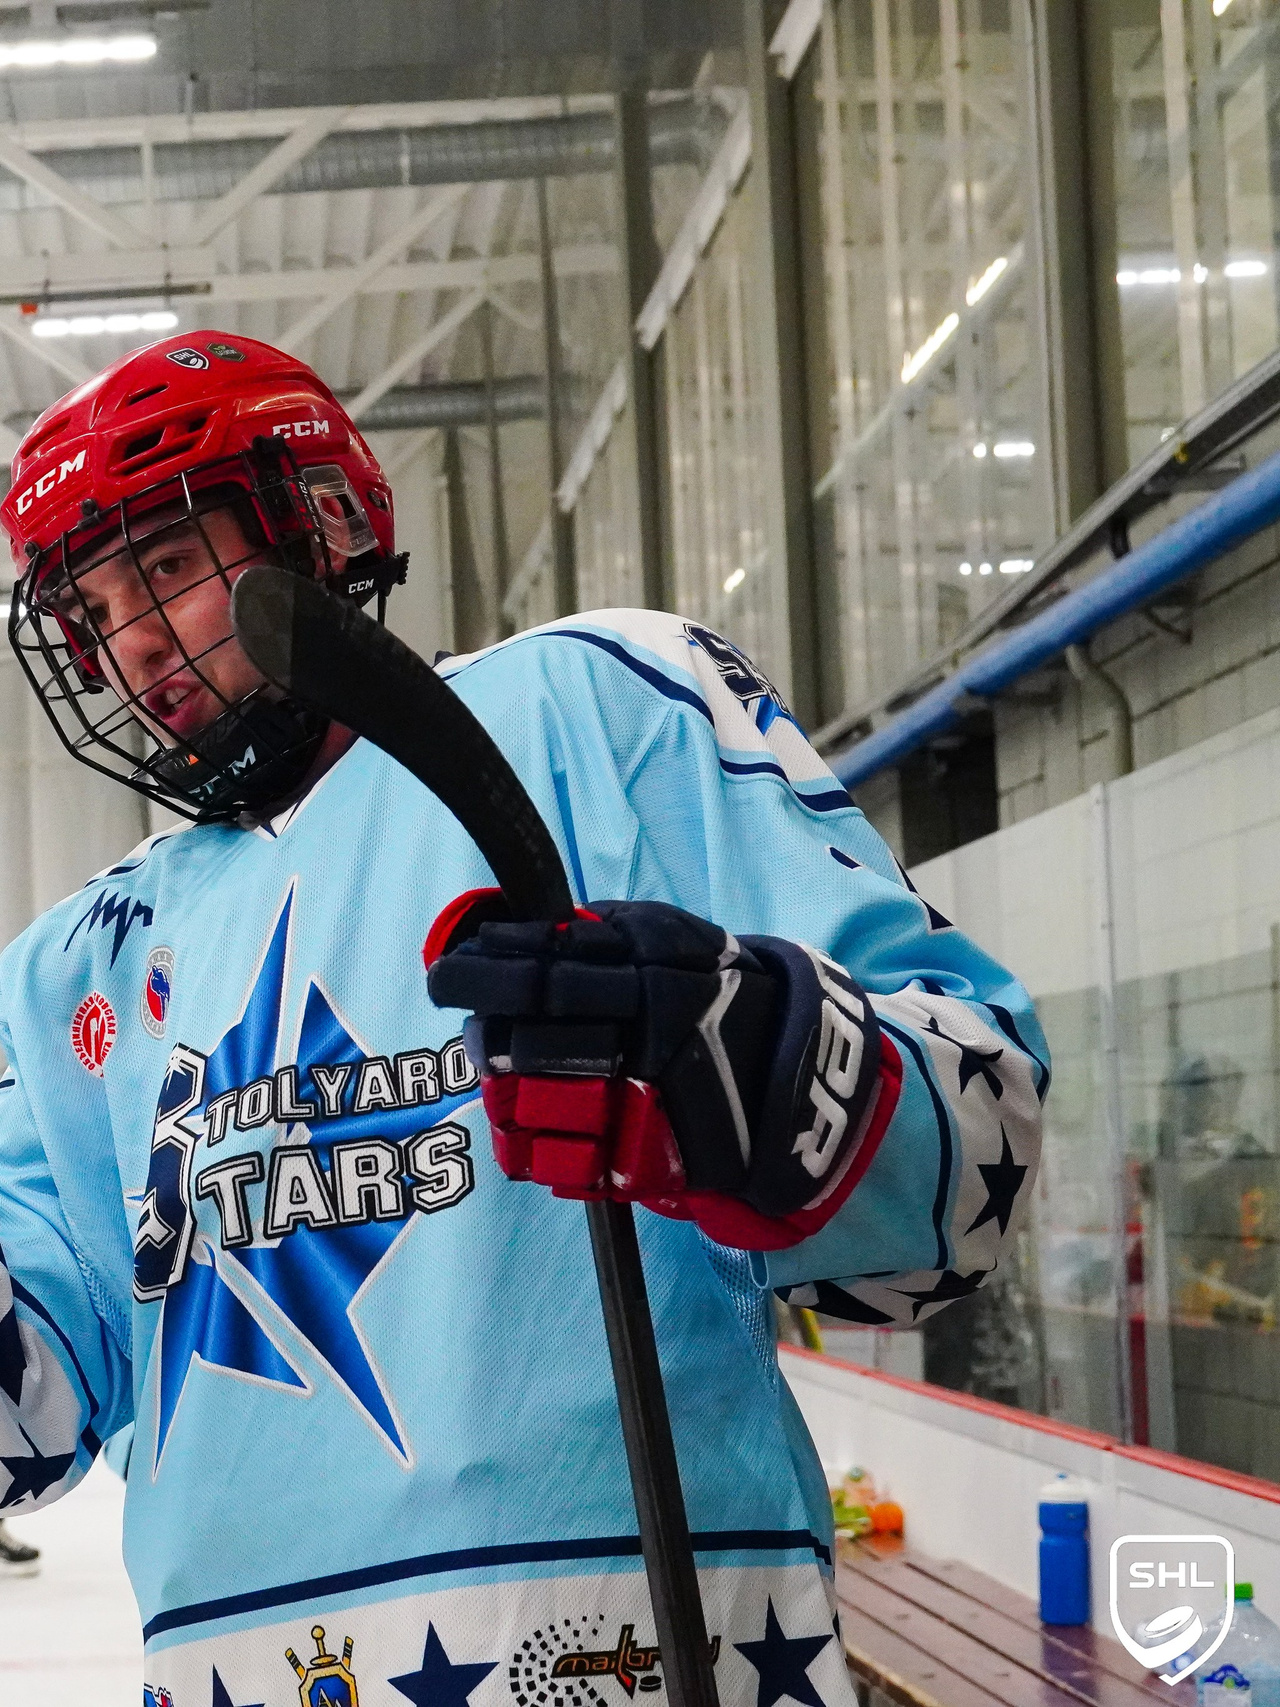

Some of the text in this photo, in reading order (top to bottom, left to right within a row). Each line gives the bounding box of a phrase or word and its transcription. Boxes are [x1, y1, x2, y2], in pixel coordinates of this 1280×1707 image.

[272, 419, 330, 440] CCM
[15, 449, 87, 516] CCM
[348, 577, 375, 595] CCM
